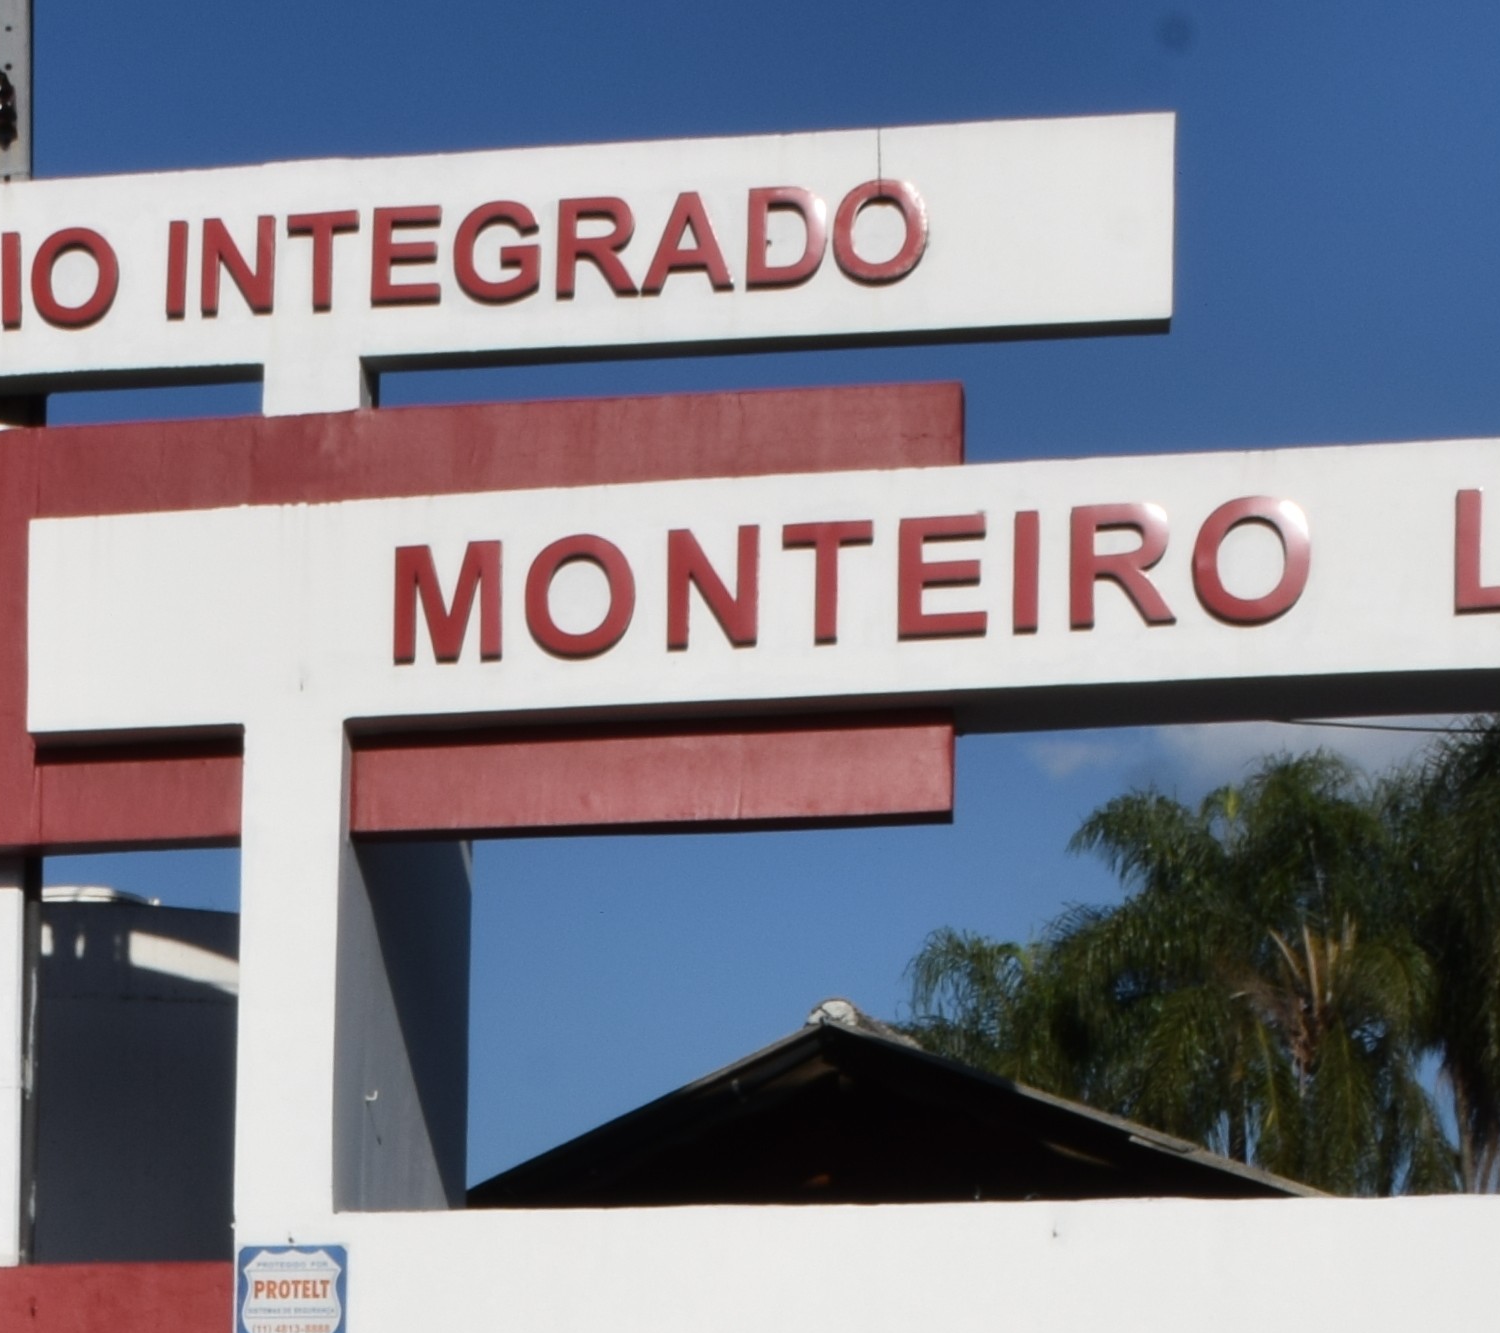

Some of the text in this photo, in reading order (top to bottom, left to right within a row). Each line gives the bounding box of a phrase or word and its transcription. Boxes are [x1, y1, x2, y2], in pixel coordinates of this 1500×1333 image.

[165, 177, 928, 321] INTEGRADO
[392, 494, 1312, 665] MONTEIRO
[253, 1279, 331, 1299] PROTELT
